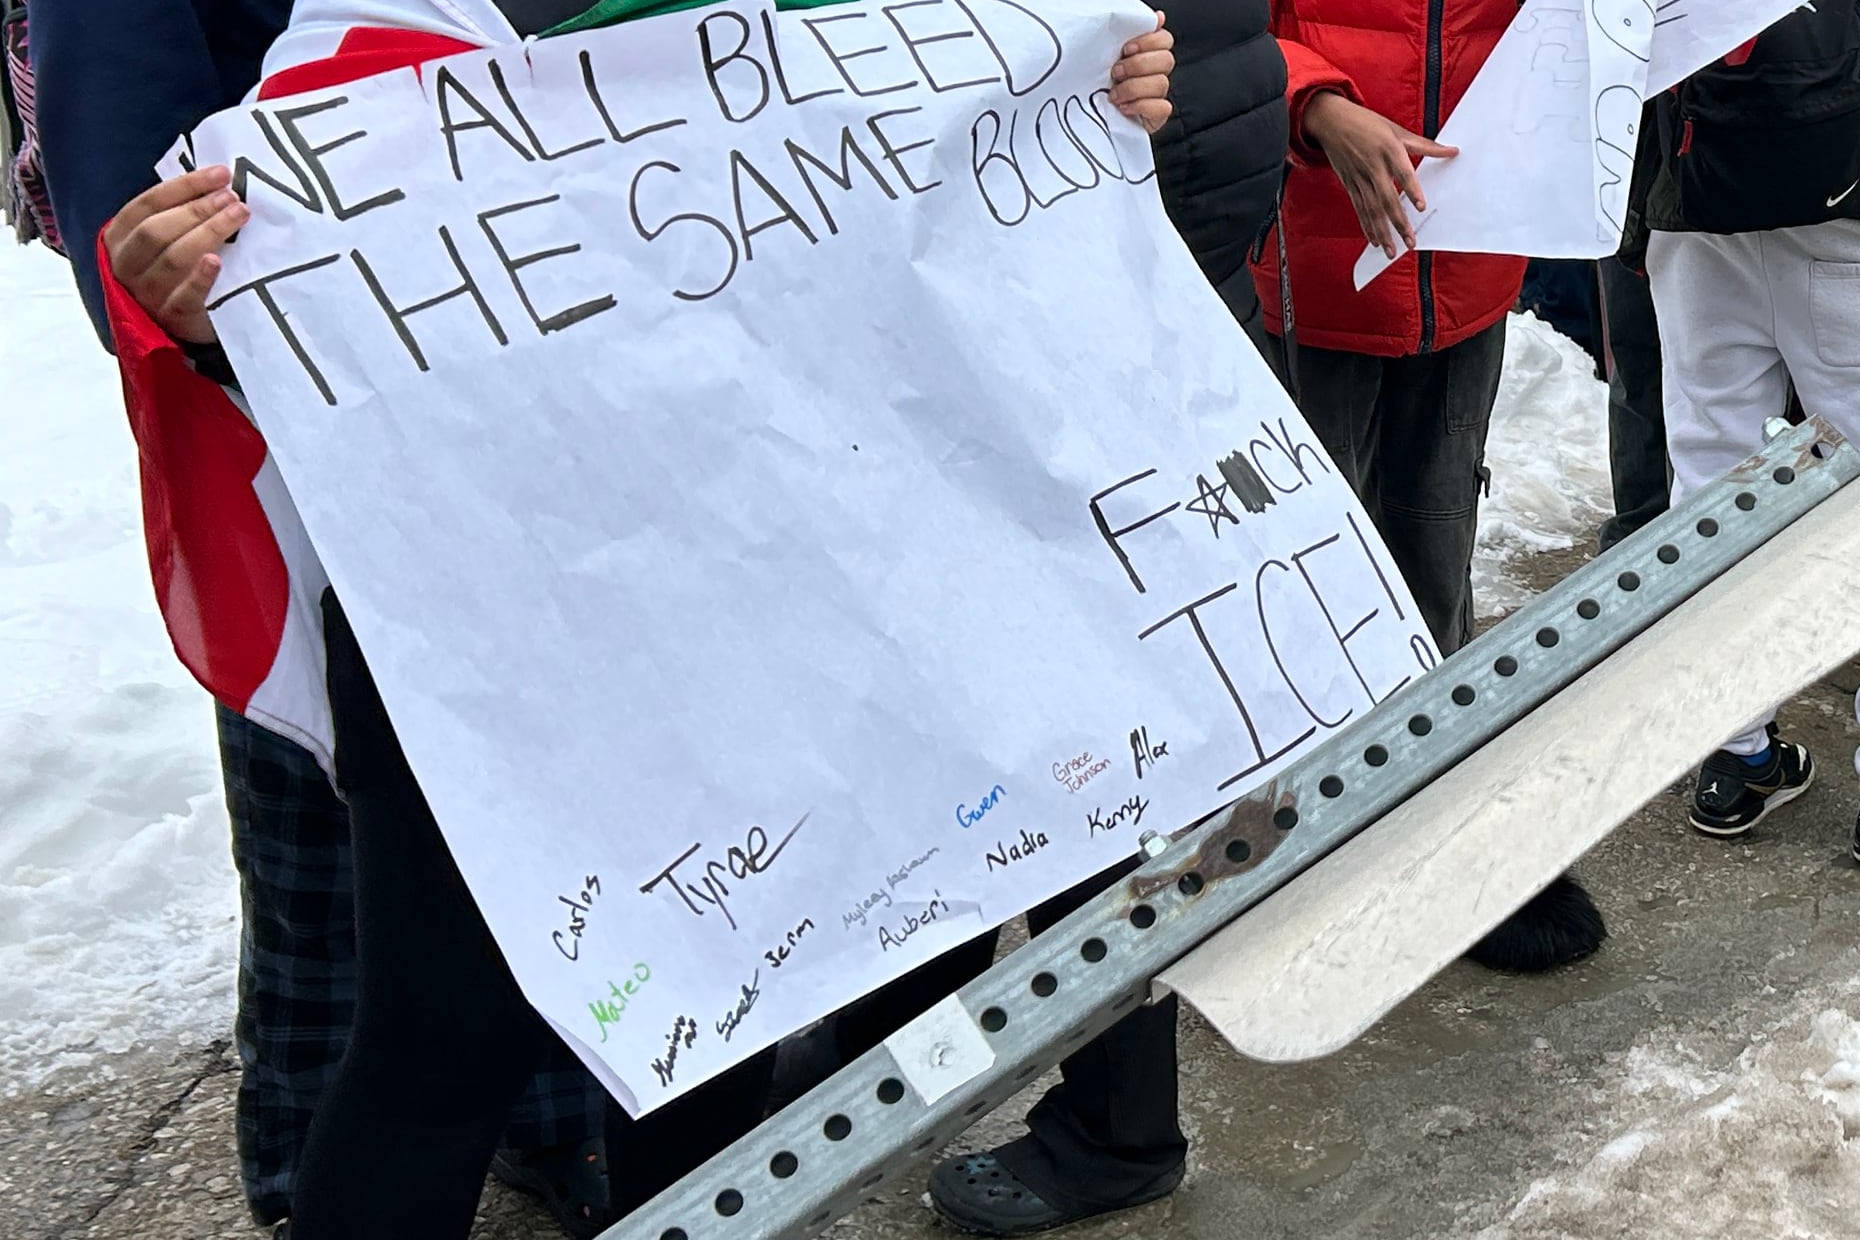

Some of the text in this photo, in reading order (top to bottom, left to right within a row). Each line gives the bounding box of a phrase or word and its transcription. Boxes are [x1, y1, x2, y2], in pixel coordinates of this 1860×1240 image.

[436, 48, 688, 181] ALL
[205, 193, 618, 406] THE
[630, 106, 942, 301] SAME
[1051, 751, 1094, 783] Grace
[1062, 757, 1112, 795] Johnson
[1129, 725, 1169, 779] Alex
[956, 783, 1008, 829] Gwen
[985, 829, 1050, 873] Nadia
[551, 874, 600, 961] Carlos
[878, 889, 950, 952] Auberi
[587, 962, 651, 1042] Mateo
